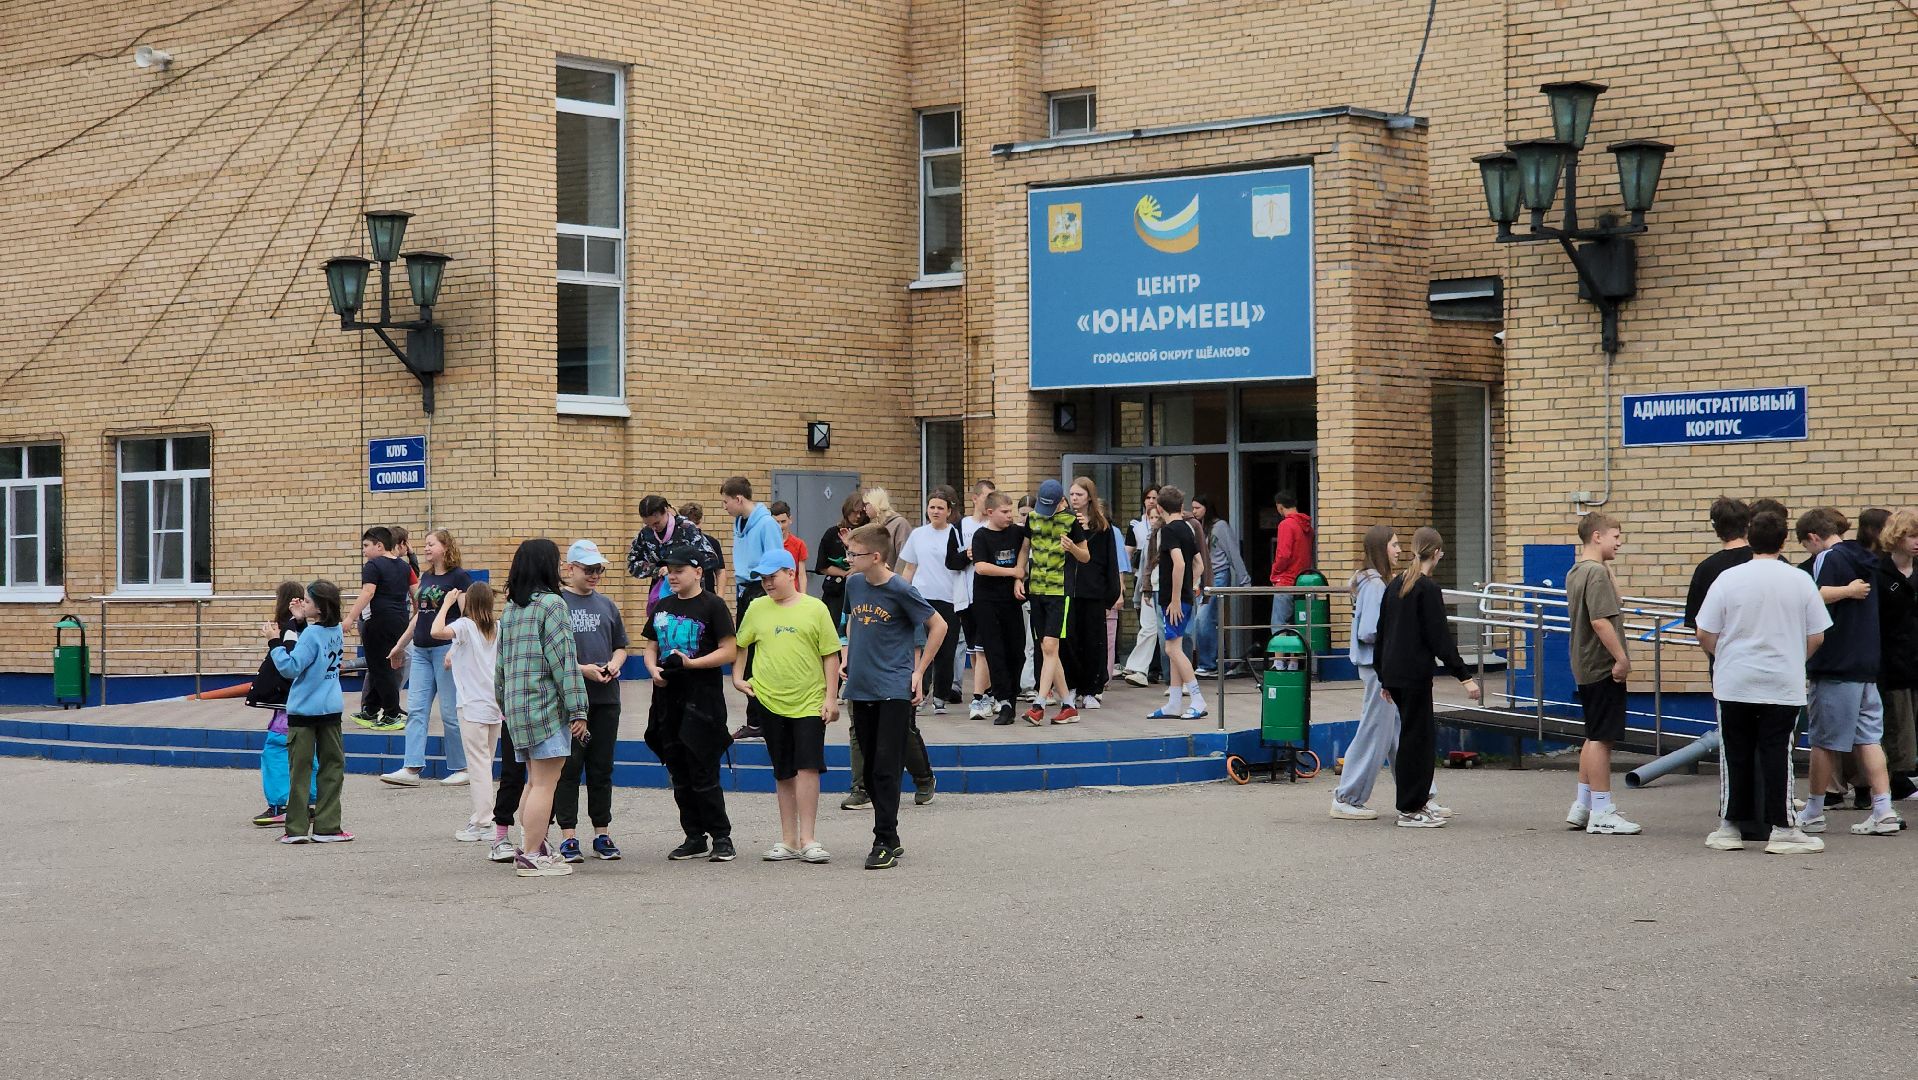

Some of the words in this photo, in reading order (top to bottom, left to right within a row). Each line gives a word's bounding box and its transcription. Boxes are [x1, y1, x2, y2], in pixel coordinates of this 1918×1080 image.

[1137, 273, 1201, 297] ЦЕНТР
[1076, 301, 1266, 334] «ЮНАРМЕЕЦ»
[1093, 348, 1158, 364] ГОРОДСКОЙ
[1159, 348, 1194, 361] ОКРУГ
[1196, 345, 1250, 360] ЩЁЛКОВО
[1632, 390, 1796, 420] АДМИНИСТРАТИВНЫЙ
[1685, 418, 1742, 437] КОРПУС
[386, 444, 408, 458] КЛУБ
[376, 470, 418, 484] СТОЛОВАЯ
